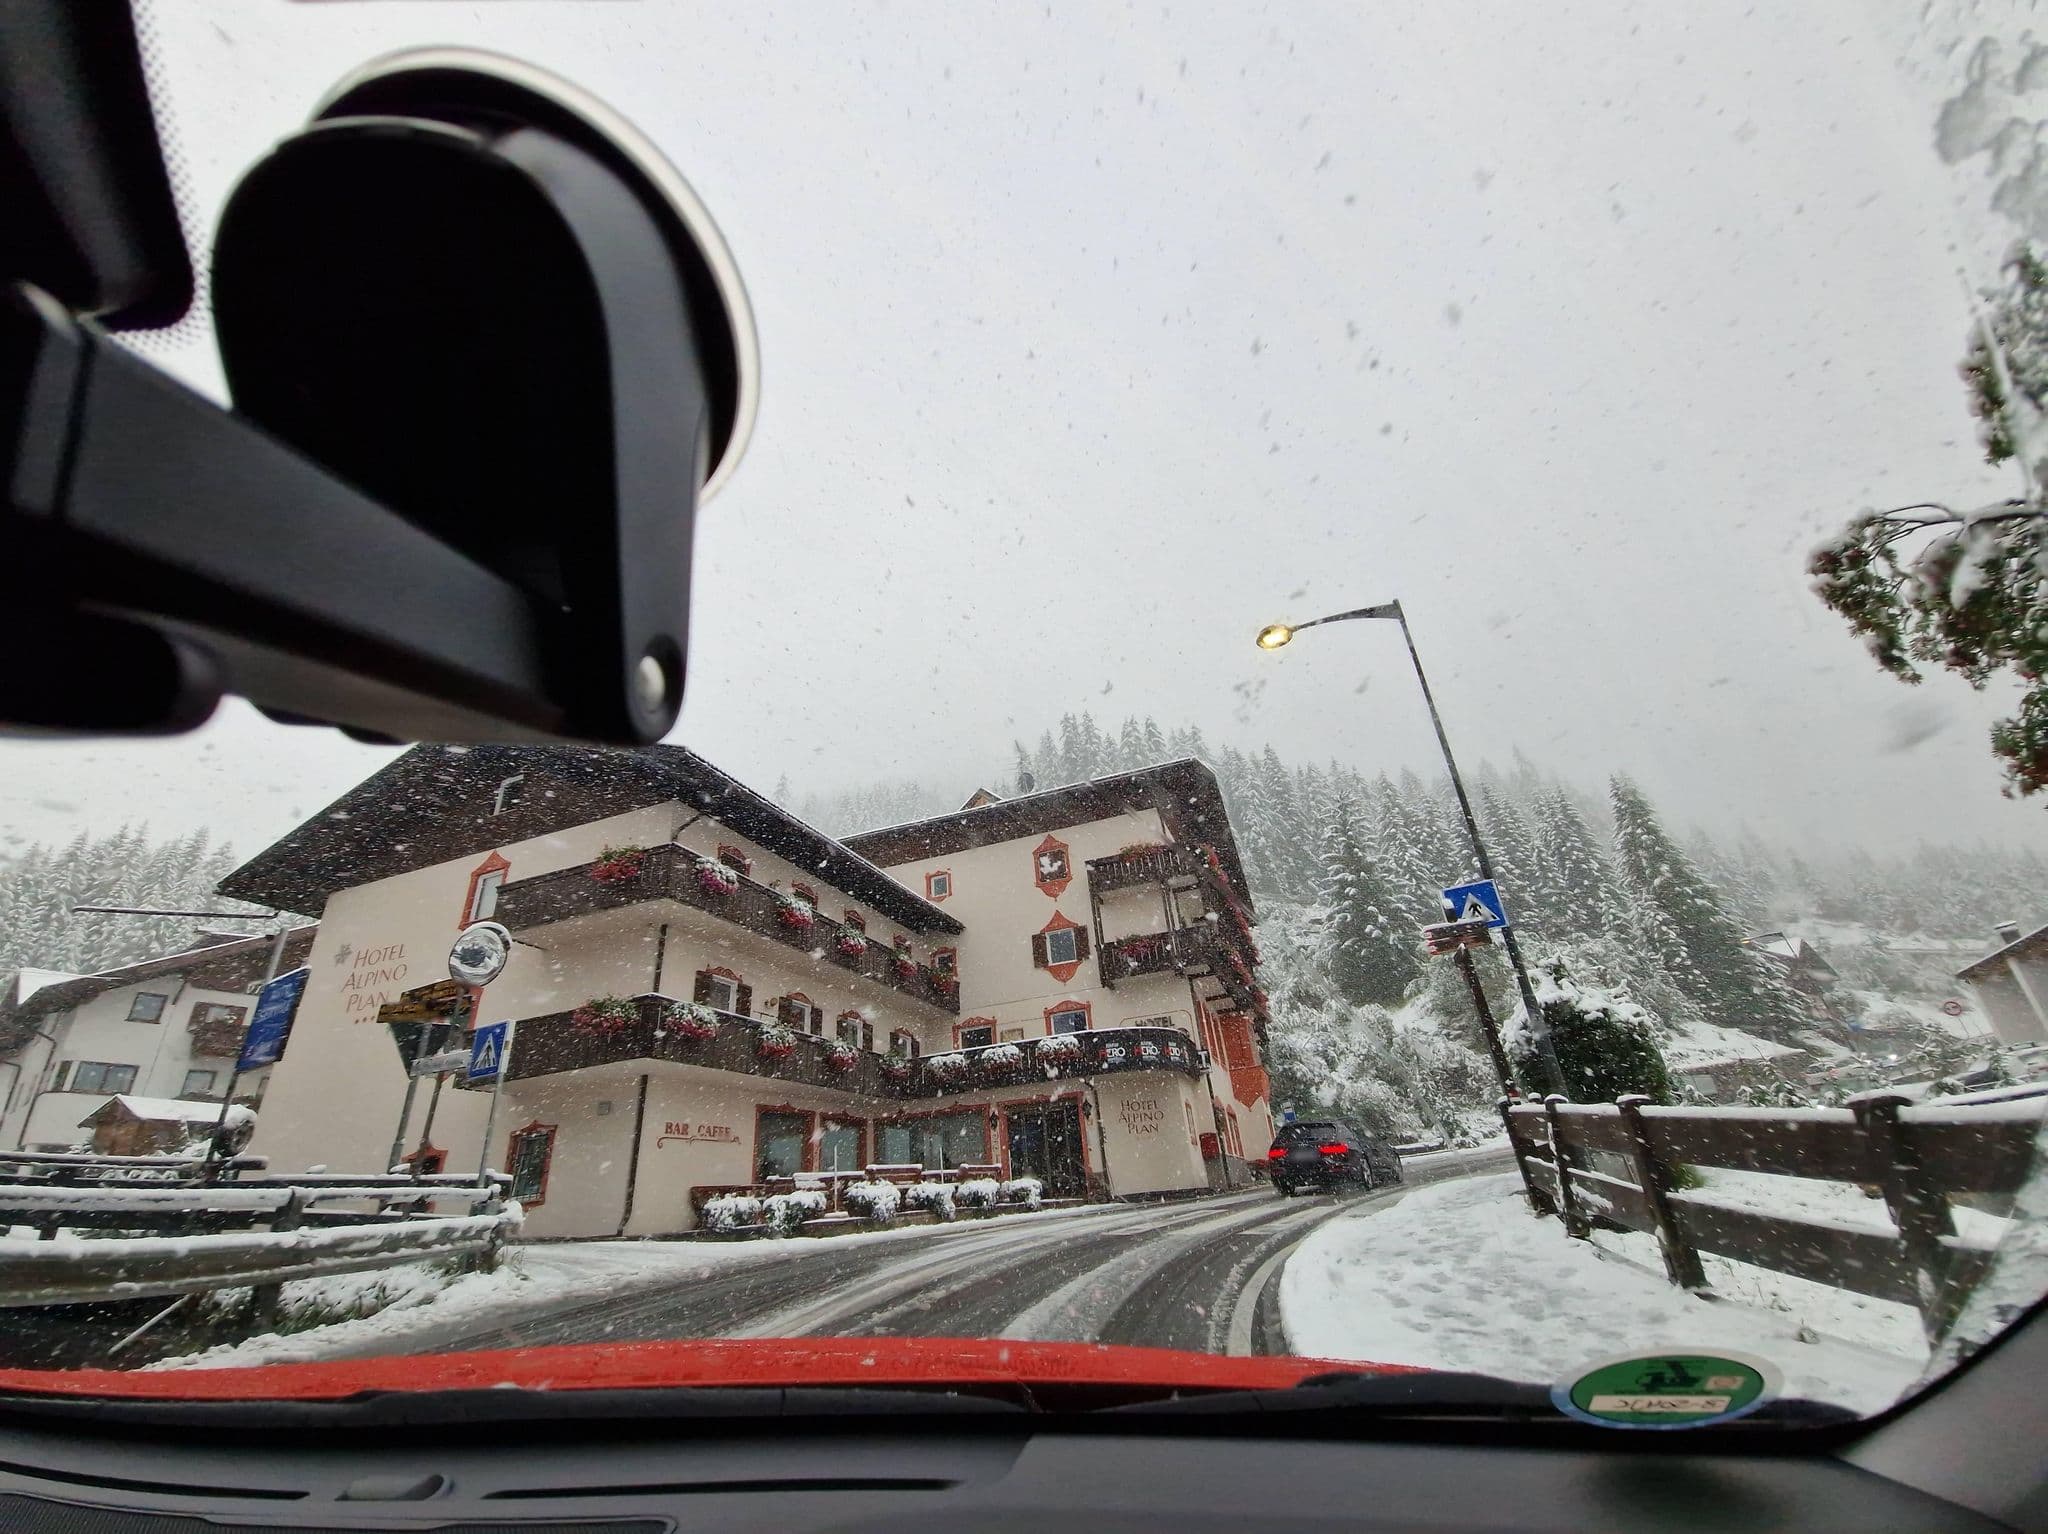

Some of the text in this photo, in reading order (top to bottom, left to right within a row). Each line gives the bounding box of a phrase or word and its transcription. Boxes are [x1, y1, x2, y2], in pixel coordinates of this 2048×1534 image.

[353, 943, 405, 969] HOTEL
[340, 963, 408, 993] ALPINO
[345, 991, 390, 1014] PLAN
[1120, 1099, 1159, 1112] HOTEL
[1119, 1111, 1164, 1123] ALPINO
[664, 1122, 689, 1136] BAR
[1128, 1122, 1159, 1134] PLAN
